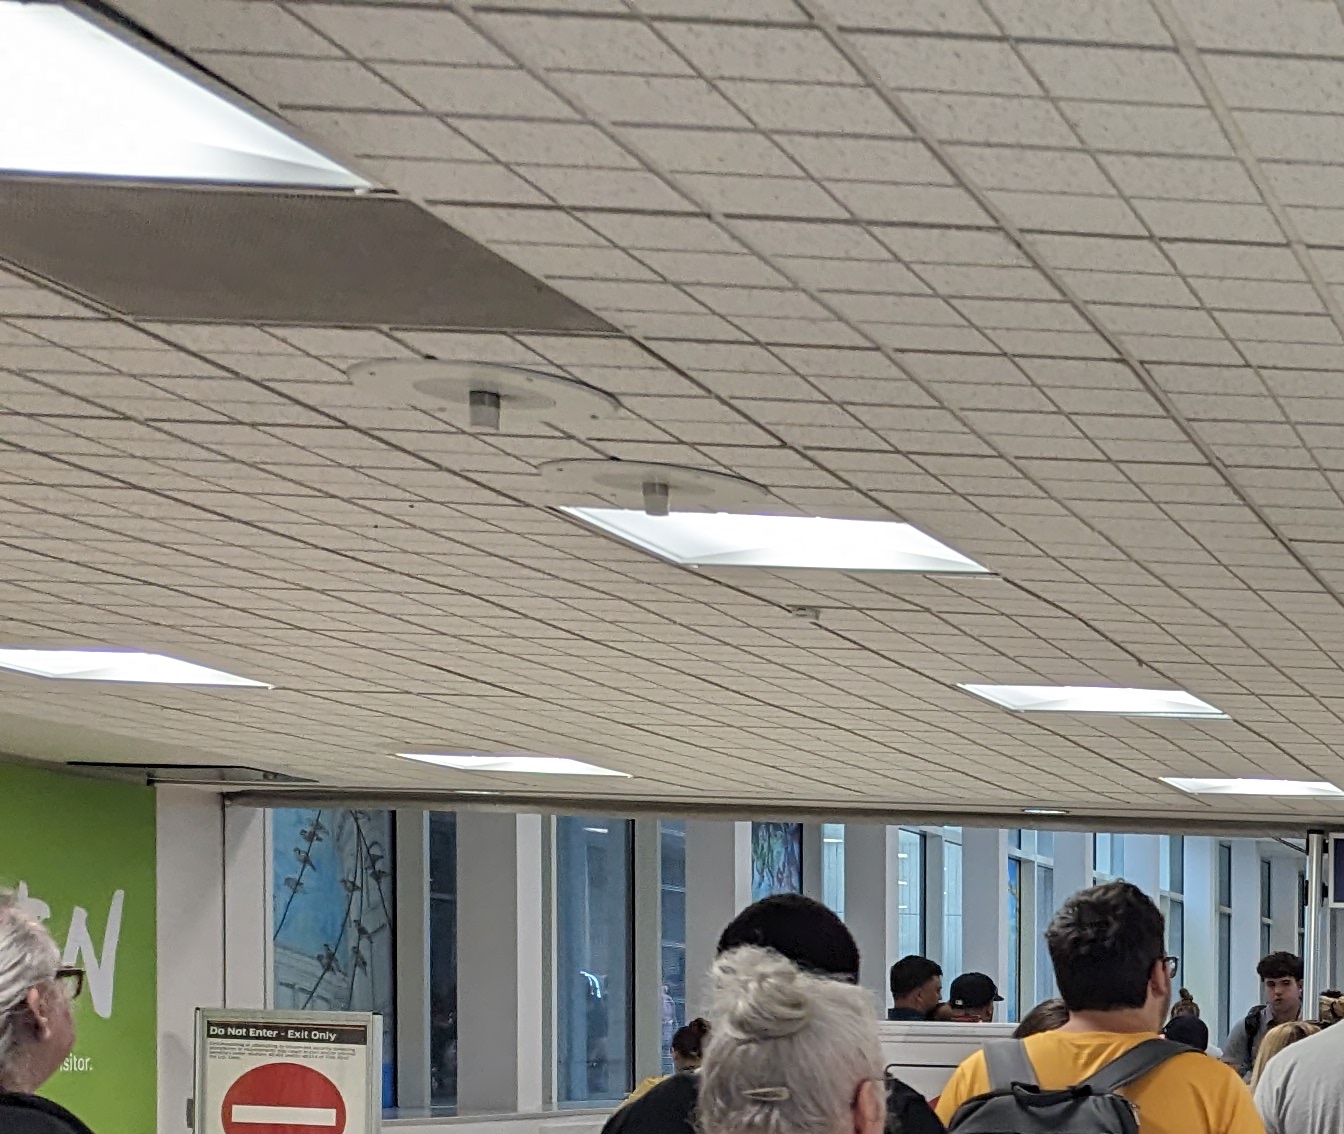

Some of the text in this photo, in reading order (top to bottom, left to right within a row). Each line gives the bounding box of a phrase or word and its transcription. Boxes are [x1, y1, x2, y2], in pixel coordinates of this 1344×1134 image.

[210, 1025, 225, 1035] Do
[227, 1027, 247, 1037] Not
[249, 1028, 279, 1038] Enter
[287, 1030, 309, 1039] Exit
[311, 1031, 337, 1041] Only
